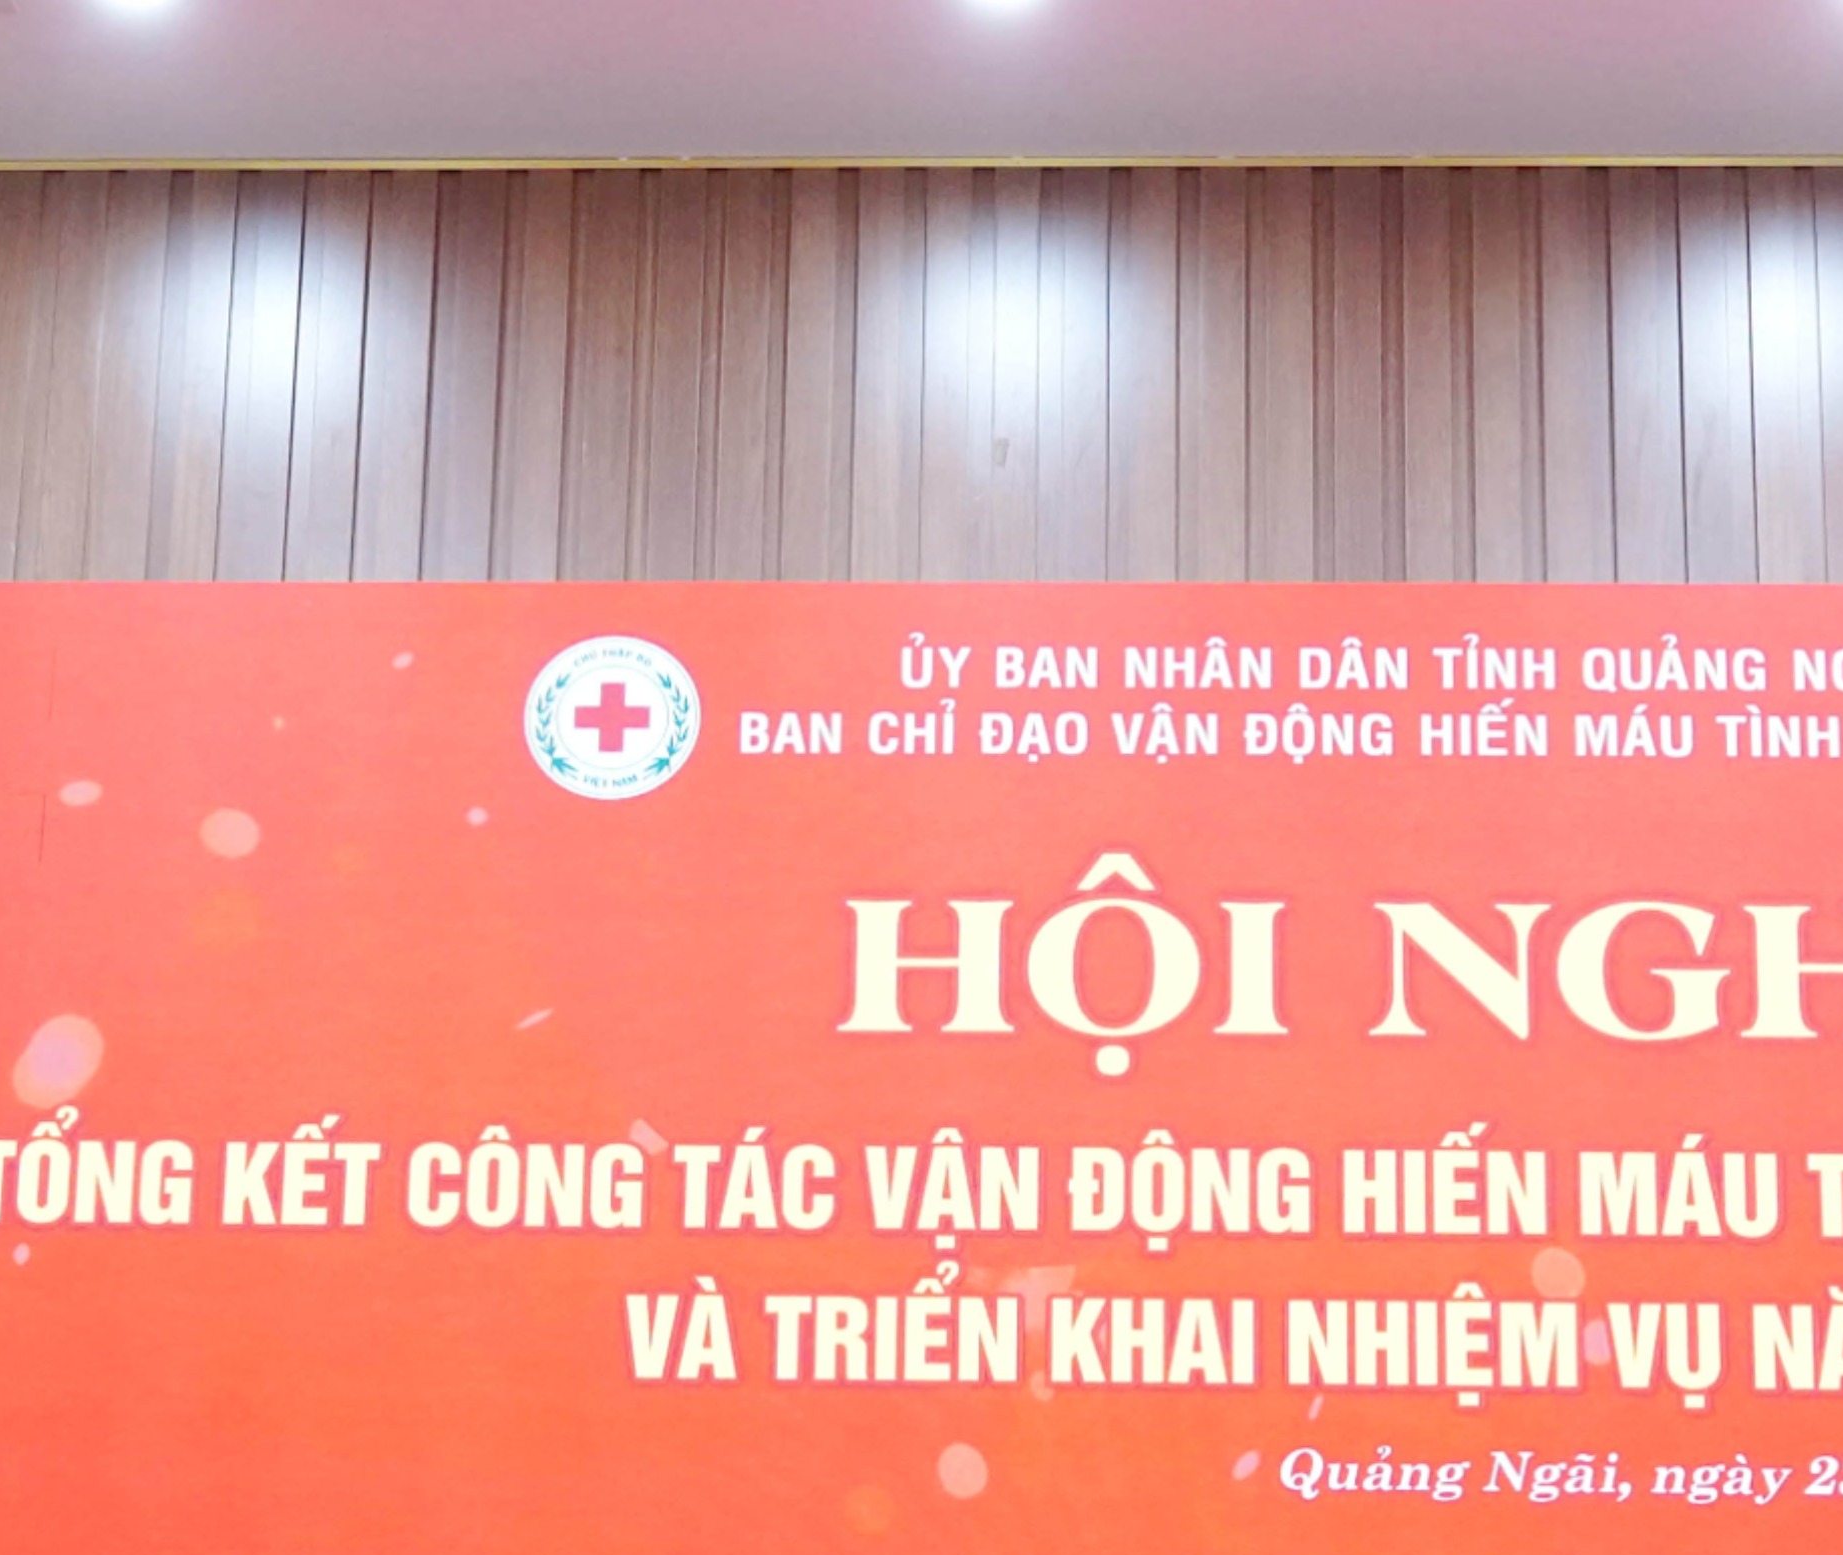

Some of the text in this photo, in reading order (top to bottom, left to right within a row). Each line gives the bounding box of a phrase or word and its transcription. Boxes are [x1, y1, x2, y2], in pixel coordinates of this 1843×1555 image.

[900, 632, 974, 690] ỦY
[996, 647, 1100, 690] BAN
[1125, 636, 1274, 691] NHÂN
[1299, 636, 1410, 691] DÂN
[1432, 633, 1558, 691] TỈNH
[1582, 633, 1768, 694] QUẢNG
[740, 711, 845, 757] BAN
[868, 699, 958, 757] CHỈ
[979, 711, 1090, 765] ĐẠO
[1110, 703, 1220, 765] VẬN
[1243, 703, 1395, 766] ĐỘNG
[1420, 695, 1550, 759] HIẾN
[1574, 704, 1696, 760] MÁU
[1716, 704, 1843, 760] TÌNH
[837, 852, 1290, 1078] HỘI
[223, 1115, 382, 1227] KẾT
[408, 1126, 645, 1230] CÔNG
[674, 1127, 837, 1231] TÁC
[866, 1129, 1041, 1250] VẬN
[1068, 1131, 1312, 1252] ĐỘNG
[1344, 1122, 1548, 1236] HIẾN
[1580, 1134, 1780, 1239] MÁU
[627, 1276, 738, 1380] VÀ
[765, 1261, 1020, 1383] TRIỂN
[1051, 1298, 1256, 1386] KHAI
[1288, 1283, 1579, 1408] NHIỆM
[1608, 1304, 1722, 1409] VỤ
[1279, 1445, 1471, 1503] Quảng
[1483, 1451, 1634, 1505] Ngãi,
[1652, 1454, 1792, 1507] ngày
